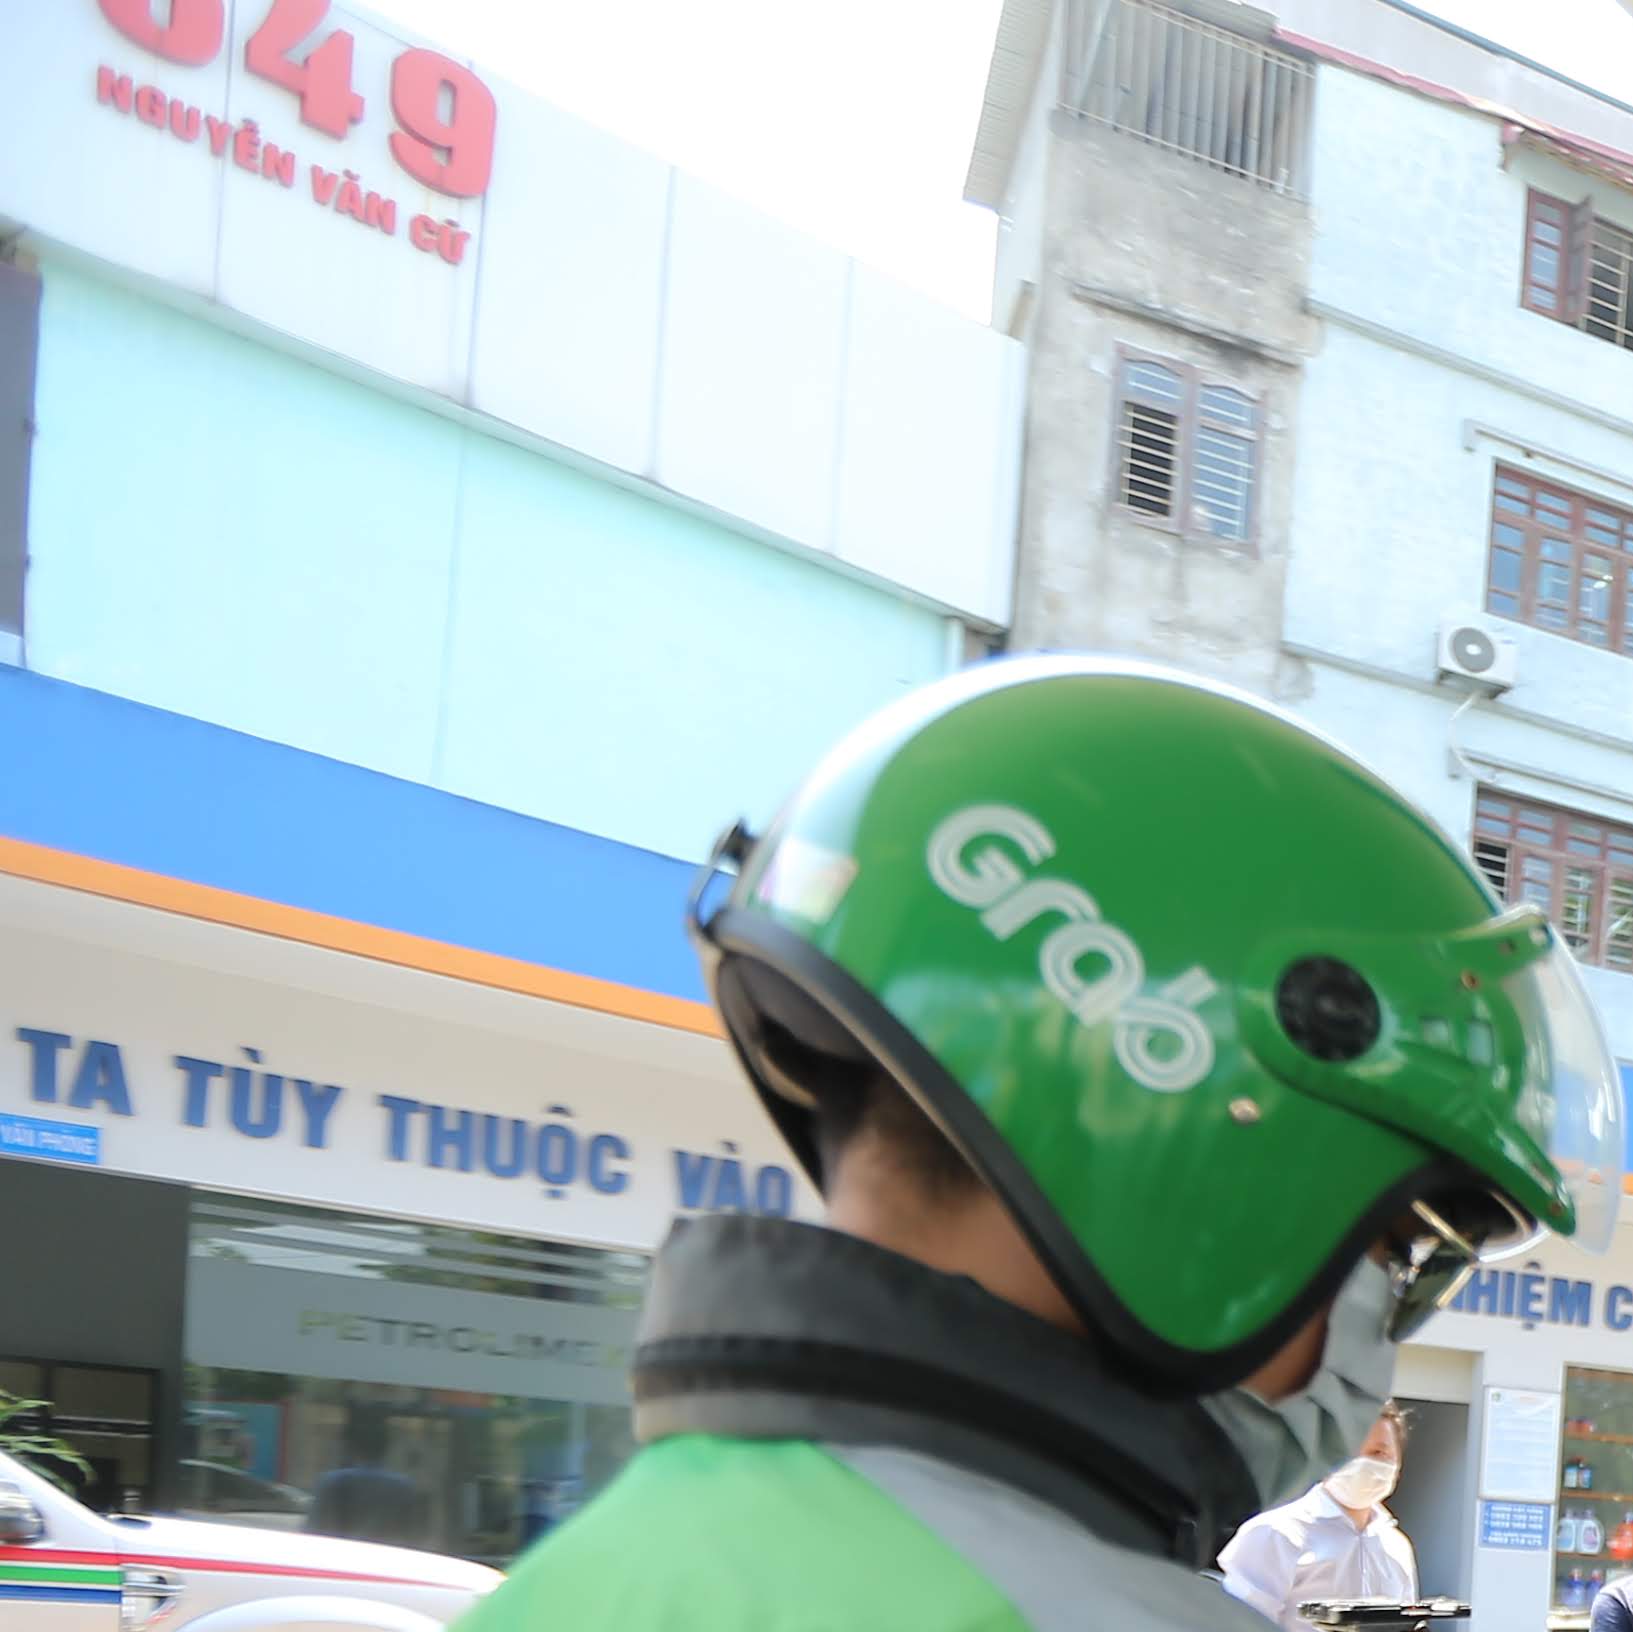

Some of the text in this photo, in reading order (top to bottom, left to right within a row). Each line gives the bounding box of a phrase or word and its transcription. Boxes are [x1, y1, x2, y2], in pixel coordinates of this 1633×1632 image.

[309, 163, 397, 236] VĂN
[926, 803, 1215, 1093] Grab
[16, 1026, 135, 1117] TA
[173, 1046, 345, 1149] TÙY
[377, 1095, 632, 1199] THUỘC
